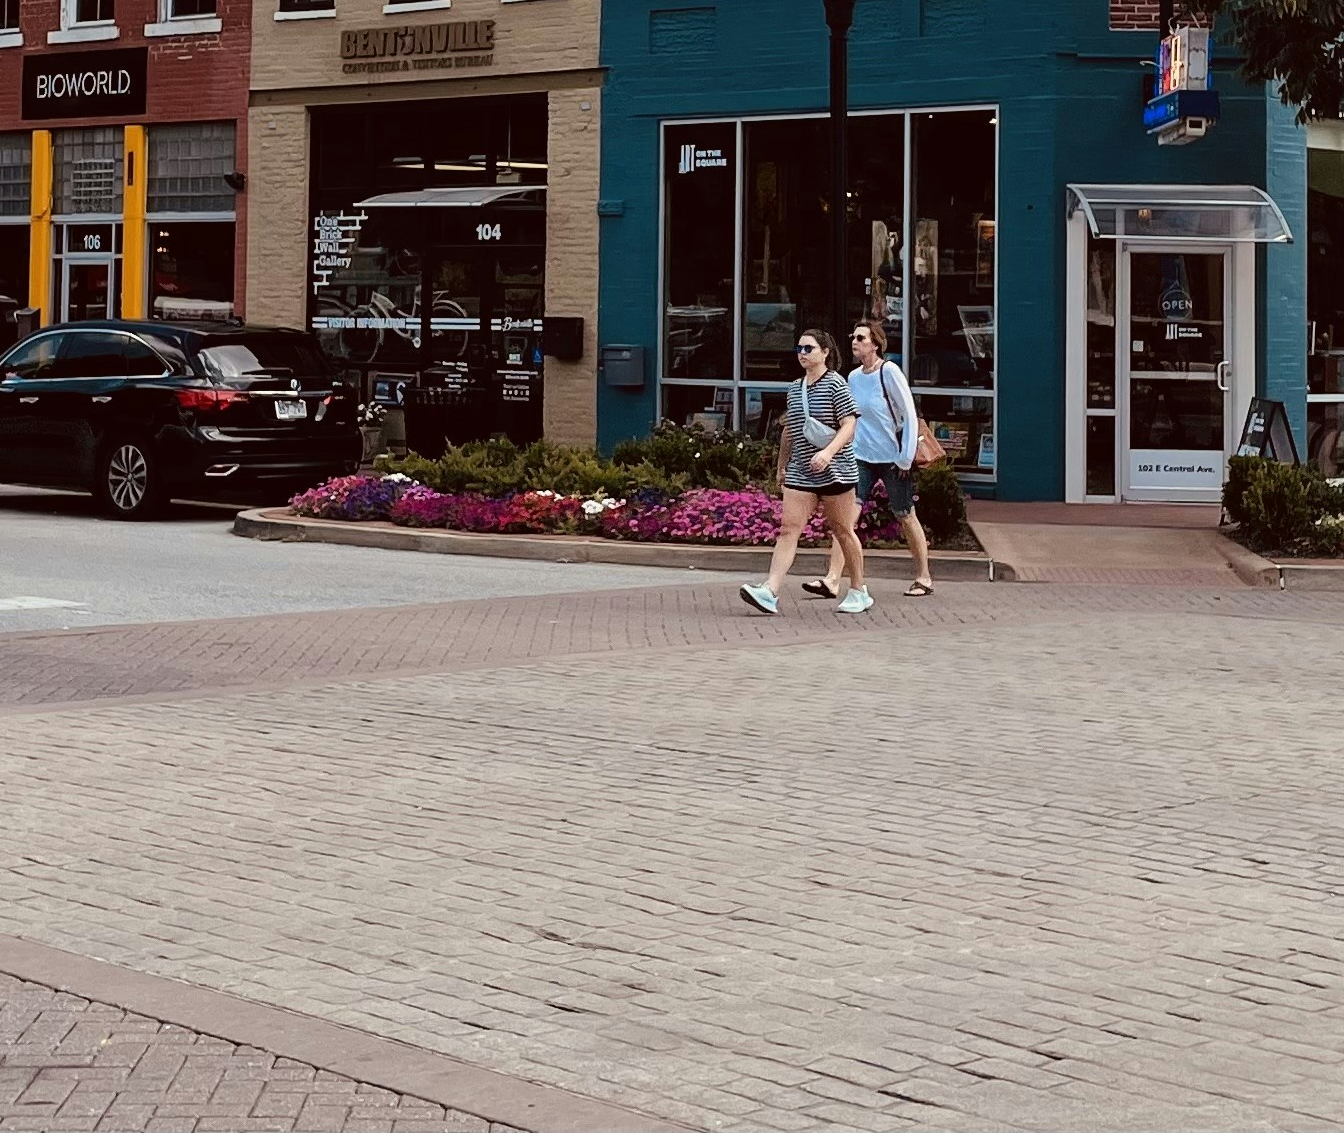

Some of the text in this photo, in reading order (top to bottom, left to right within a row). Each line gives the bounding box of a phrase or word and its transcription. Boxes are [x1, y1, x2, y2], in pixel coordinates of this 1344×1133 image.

[340, 19, 496, 59] BENTONVILLE
[37, 69, 131, 98] BIOWORLD
[696, 158, 727, 167] SQUARE
[319, 216, 338, 226] One
[319, 229, 343, 240] Brick
[476, 223, 502, 241] 104
[83, 234, 101, 250] 106
[319, 242, 339, 253] Wall
[319, 255, 352, 269] Gallery
[1161, 299, 1193, 311] OPEN
[1138, 464, 1153, 472] 102
[1163, 464, 1195, 473] Central
